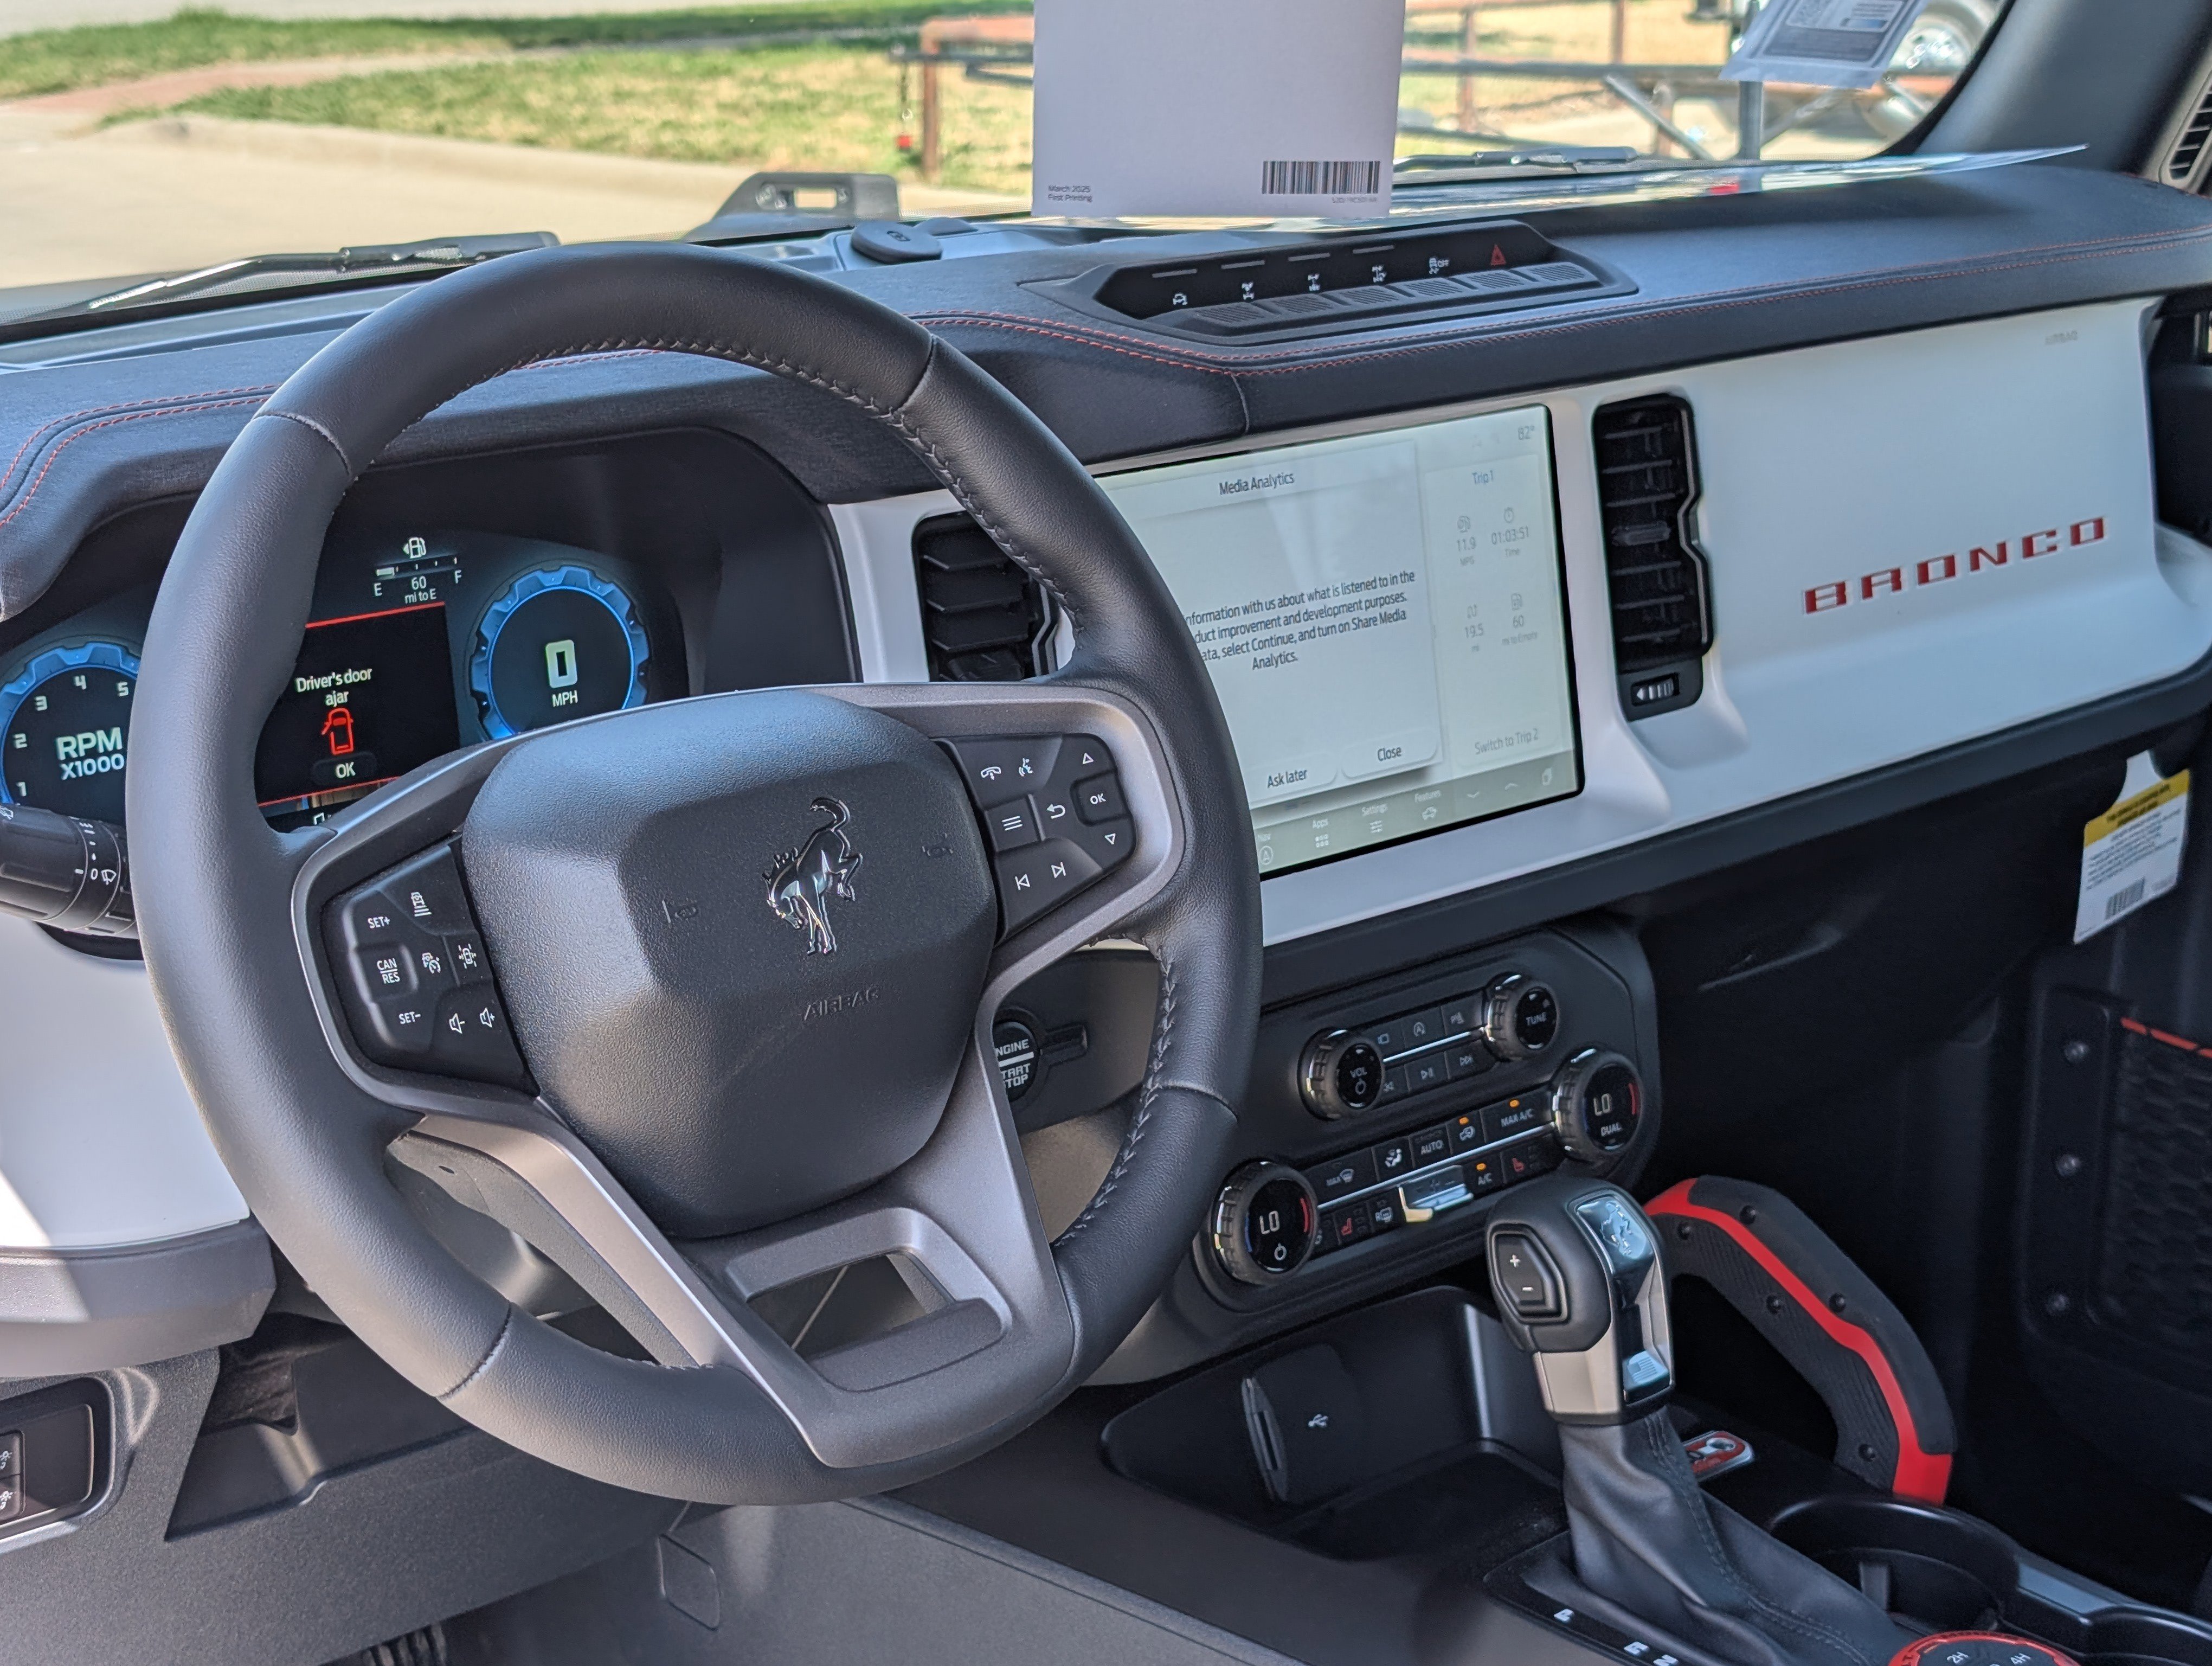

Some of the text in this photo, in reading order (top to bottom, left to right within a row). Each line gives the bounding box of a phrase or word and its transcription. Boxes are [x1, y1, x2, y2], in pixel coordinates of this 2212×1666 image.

[1219, 472, 1295, 495] Media Analytics
[1803, 515, 2106, 615] BRONCO
[411, 575, 427, 591] 60
[454, 569, 462, 584] F
[374, 582, 383, 597] E
[404, 588, 437, 604] mi to E
[1184, 571, 1415, 626] nformation with us about what is listened to in the
[1217, 615, 1282, 639] improvement
[1283, 610, 1302, 626] and
[1302, 599, 1364, 622] development
[1364, 591, 1407, 612] purposes.
[1201, 608, 1407, 662] ata, select Continue, and turn on Share Media
[545, 639, 577, 688] 0
[1252, 651, 1298, 670] Analytics.
[73, 675, 87, 690] 4
[295, 668, 372, 693] Driver's door
[117, 682, 129, 697] 5
[34, 695, 48, 712] 3
[325, 690, 349, 707] ajar
[552, 691, 578, 707] MPH
[14, 733, 27, 749] 2
[56, 727, 123, 761] RPM
[1504, 736, 1514, 748] to
[1377, 746, 1402, 762] Close
[60, 753, 125, 781] X1000
[336, 761, 356, 779] OK
[1267, 769, 1307, 789] Ask later
[16, 781, 27, 797] 1
[1090, 793, 1107, 805] OK
[368, 916, 391, 929] SET+
[376, 958, 397, 971] CAN
[382, 972, 401, 984] RES
[1525, 1011, 1547, 1027] TUNE
[995, 1038, 1030, 1058] NGINE
[1002, 1063, 1031, 1080] TART
[1349, 1067, 1367, 1079] VOL
[1004, 1074, 1029, 1089] TOP
[1600, 1122, 1623, 1137] DUAL
[1420, 1139, 1444, 1155] AUTO
[1478, 1172, 1493, 1186] A/C
[1553, 1608, 1574, 1623] P
[1946, 1651, 1969, 1664] 2H
[2010, 1652, 2031, 1665] 4H
